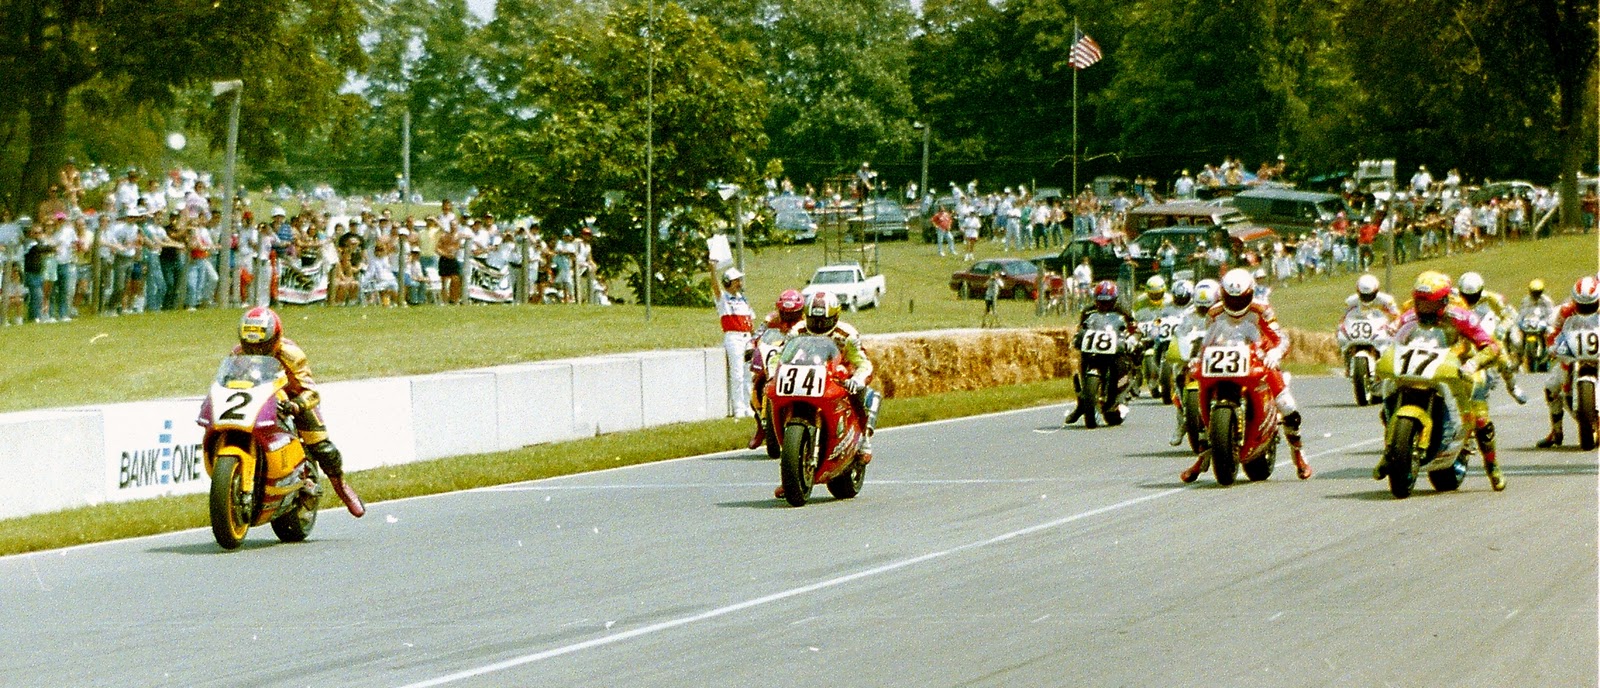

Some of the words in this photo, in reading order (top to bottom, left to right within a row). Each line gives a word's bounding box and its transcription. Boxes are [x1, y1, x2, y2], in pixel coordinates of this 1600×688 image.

[1086, 332, 1112, 351] 18
[1351, 322, 1372, 339] 39
[1576, 332, 1599, 356] 19
[1210, 350, 1240, 373] 23
[1401, 348, 1439, 376] 17
[783, 367, 816, 395] 34
[219, 391, 253, 420] 2
[119, 448, 161, 489] BANK
[172, 443, 203, 484] ONE
